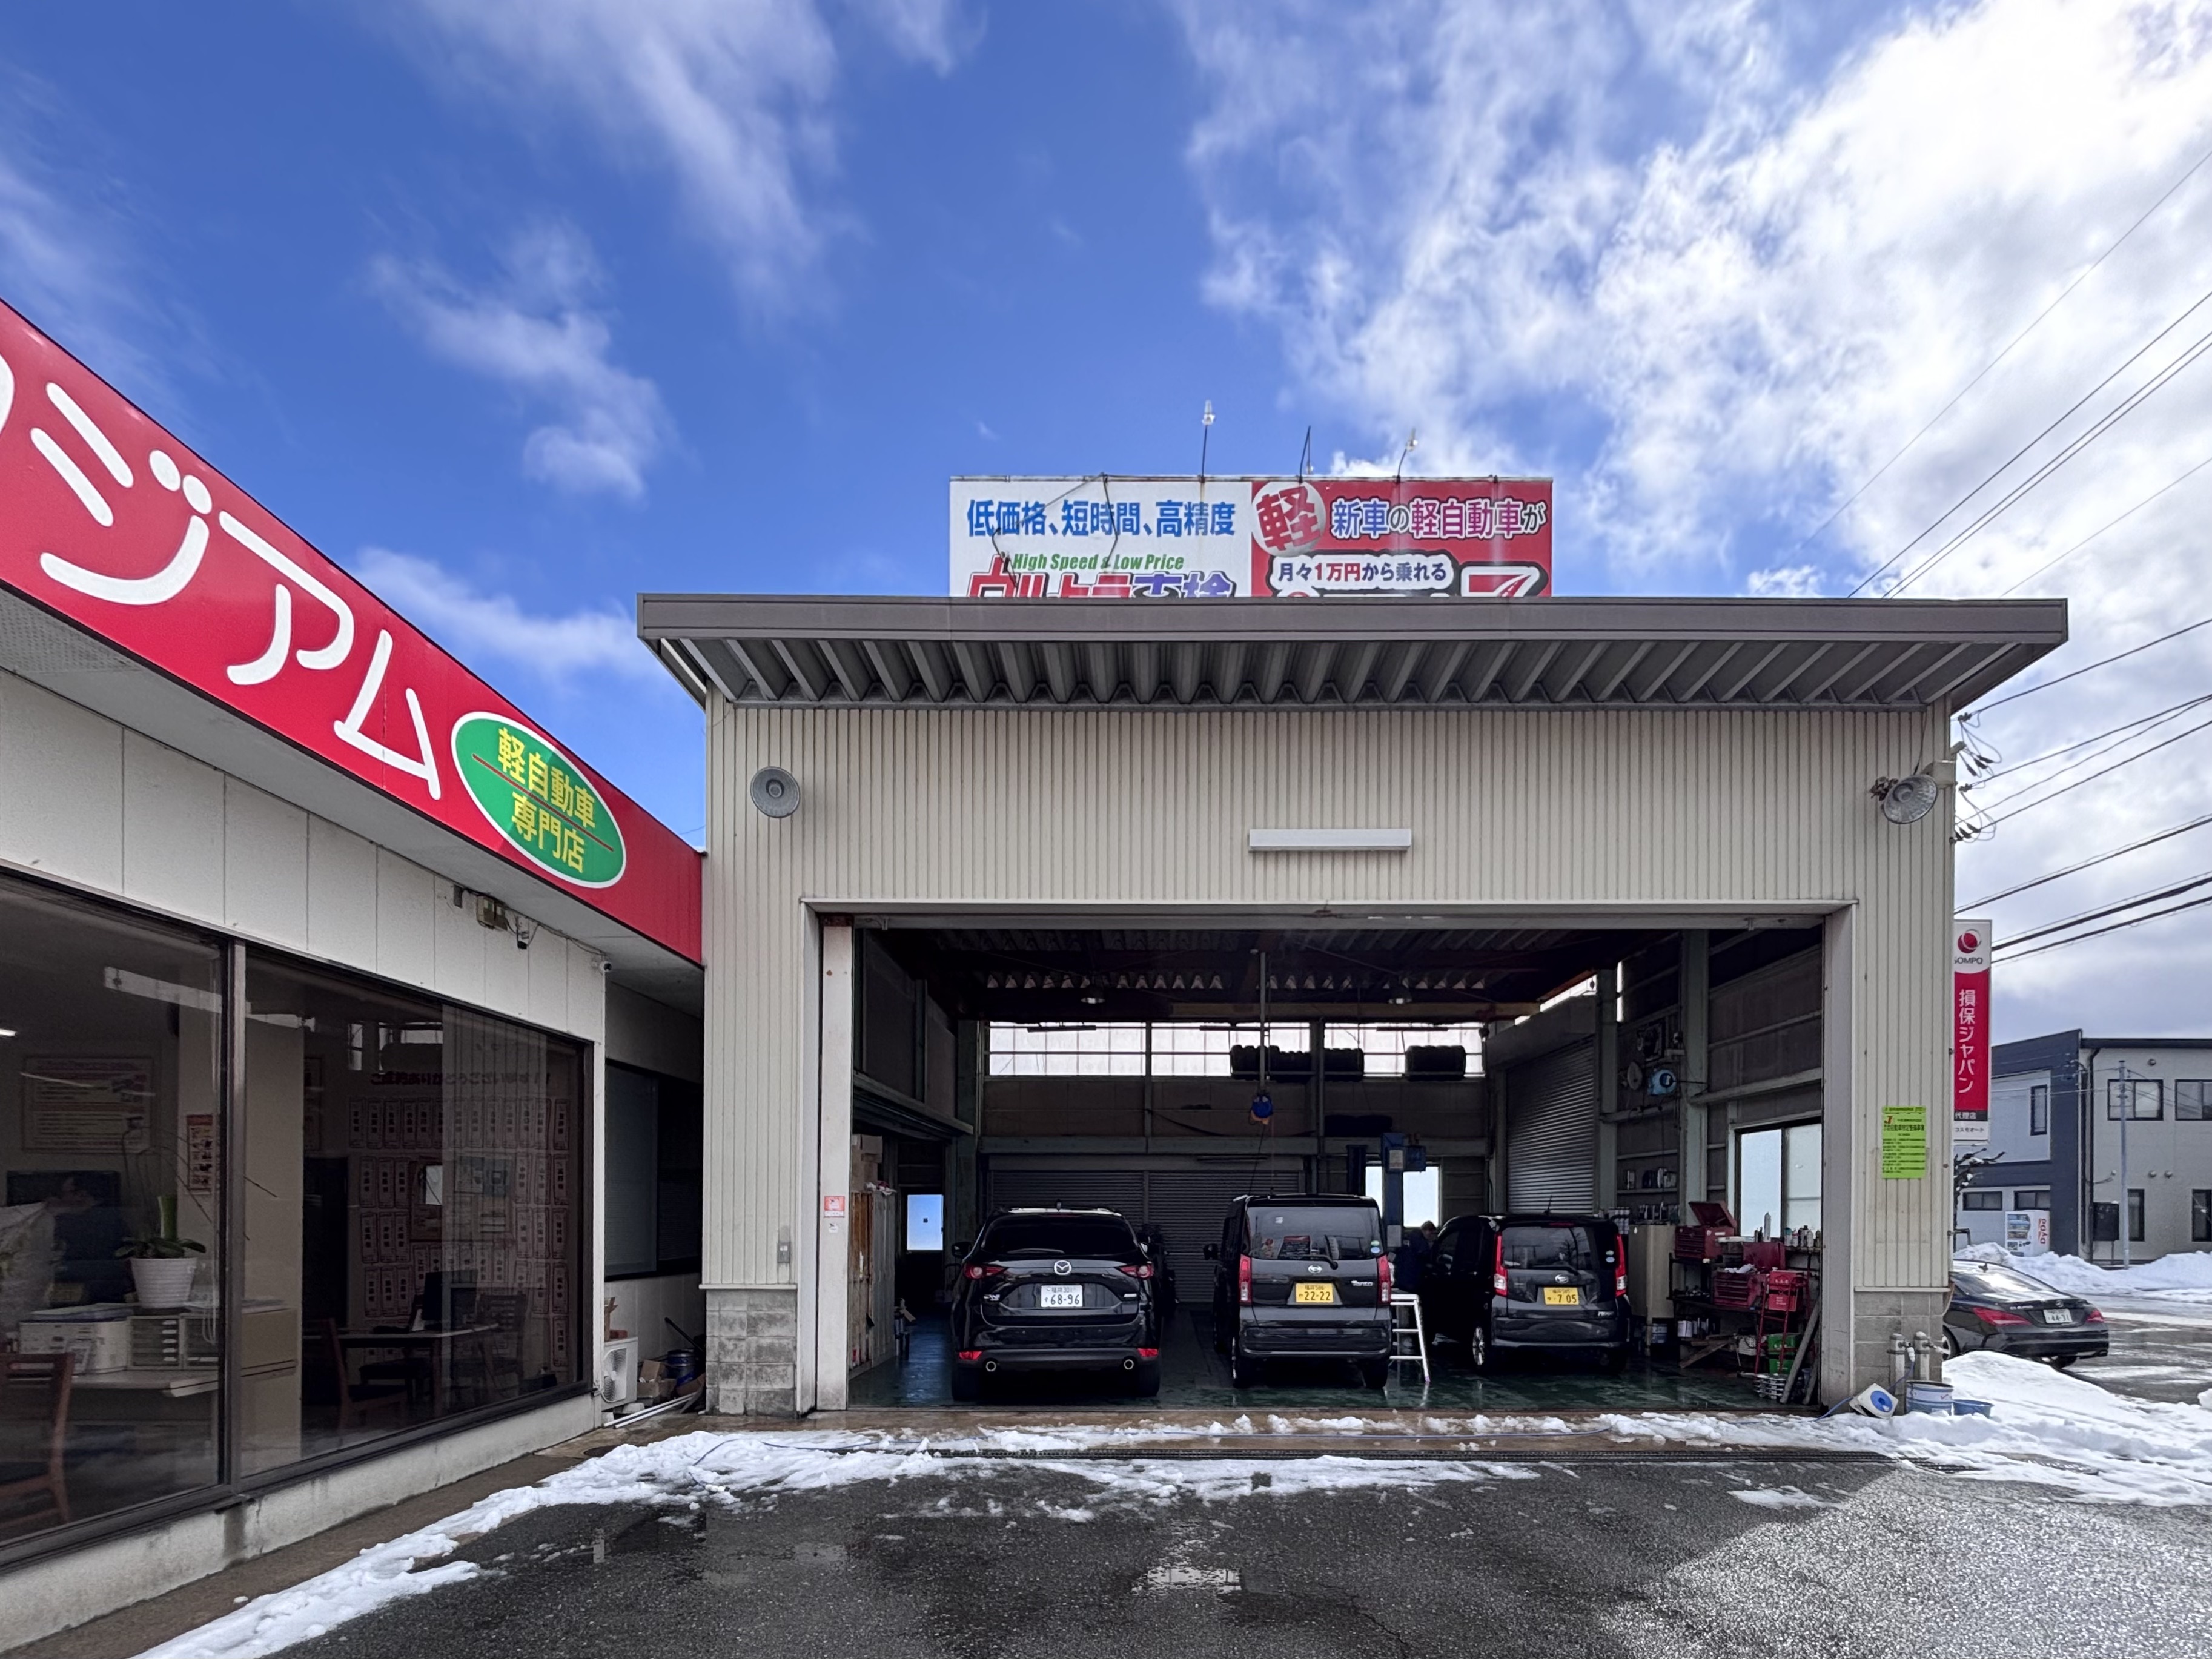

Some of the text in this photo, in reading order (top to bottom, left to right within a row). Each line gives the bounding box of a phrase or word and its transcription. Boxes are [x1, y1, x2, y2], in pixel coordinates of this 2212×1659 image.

[967, 499, 1236, 538] 低価格、短時間、高精度
[1256, 485, 1322, 551] 軽
[1331, 498, 1547, 539] 新車の軽自動車が
[0, 355, 441, 800] ジアム
[1013, 554, 1047, 571] High
[1050, 554, 1099, 571] Speed
[1113, 554, 1143, 569] Low
[1144, 554, 1184, 570] Price
[1279, 562, 1446, 582] 月々1万円から乗れる
[498, 727, 595, 829] 軽自動車
[512, 791, 584, 873] 専門店
[1958, 989, 1976, 1093] 損保ジャパン
